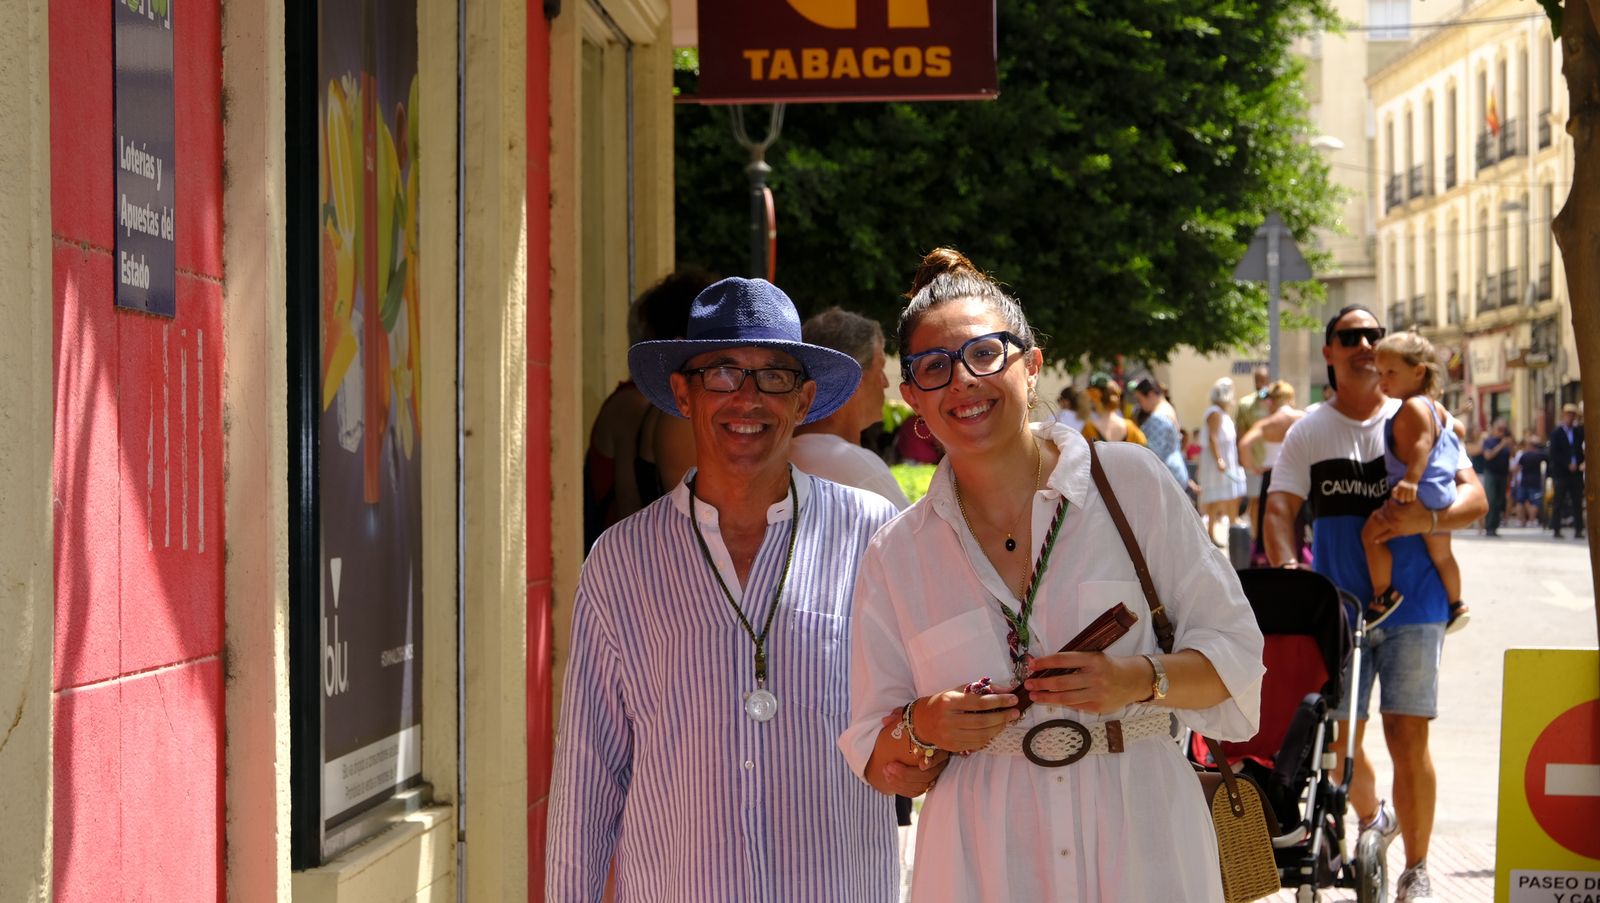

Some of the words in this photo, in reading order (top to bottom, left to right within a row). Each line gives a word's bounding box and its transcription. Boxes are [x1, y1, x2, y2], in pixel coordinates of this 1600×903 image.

[743, 46, 951, 80] TABACOS
[120, 136, 155, 180] Loterías
[156, 157, 162, 191] y
[120, 194, 159, 237] Apuestas
[161, 206, 174, 241] del
[121, 251, 150, 290] Estado
[1321, 479, 1368, 497] CALVIN
[1368, 478, 1389, 498] KLE
[324, 615, 348, 697] blu
[1519, 876, 1579, 890] PASEO
[1584, 878, 1600, 890] D
[1554, 893, 1565, 903] Y
